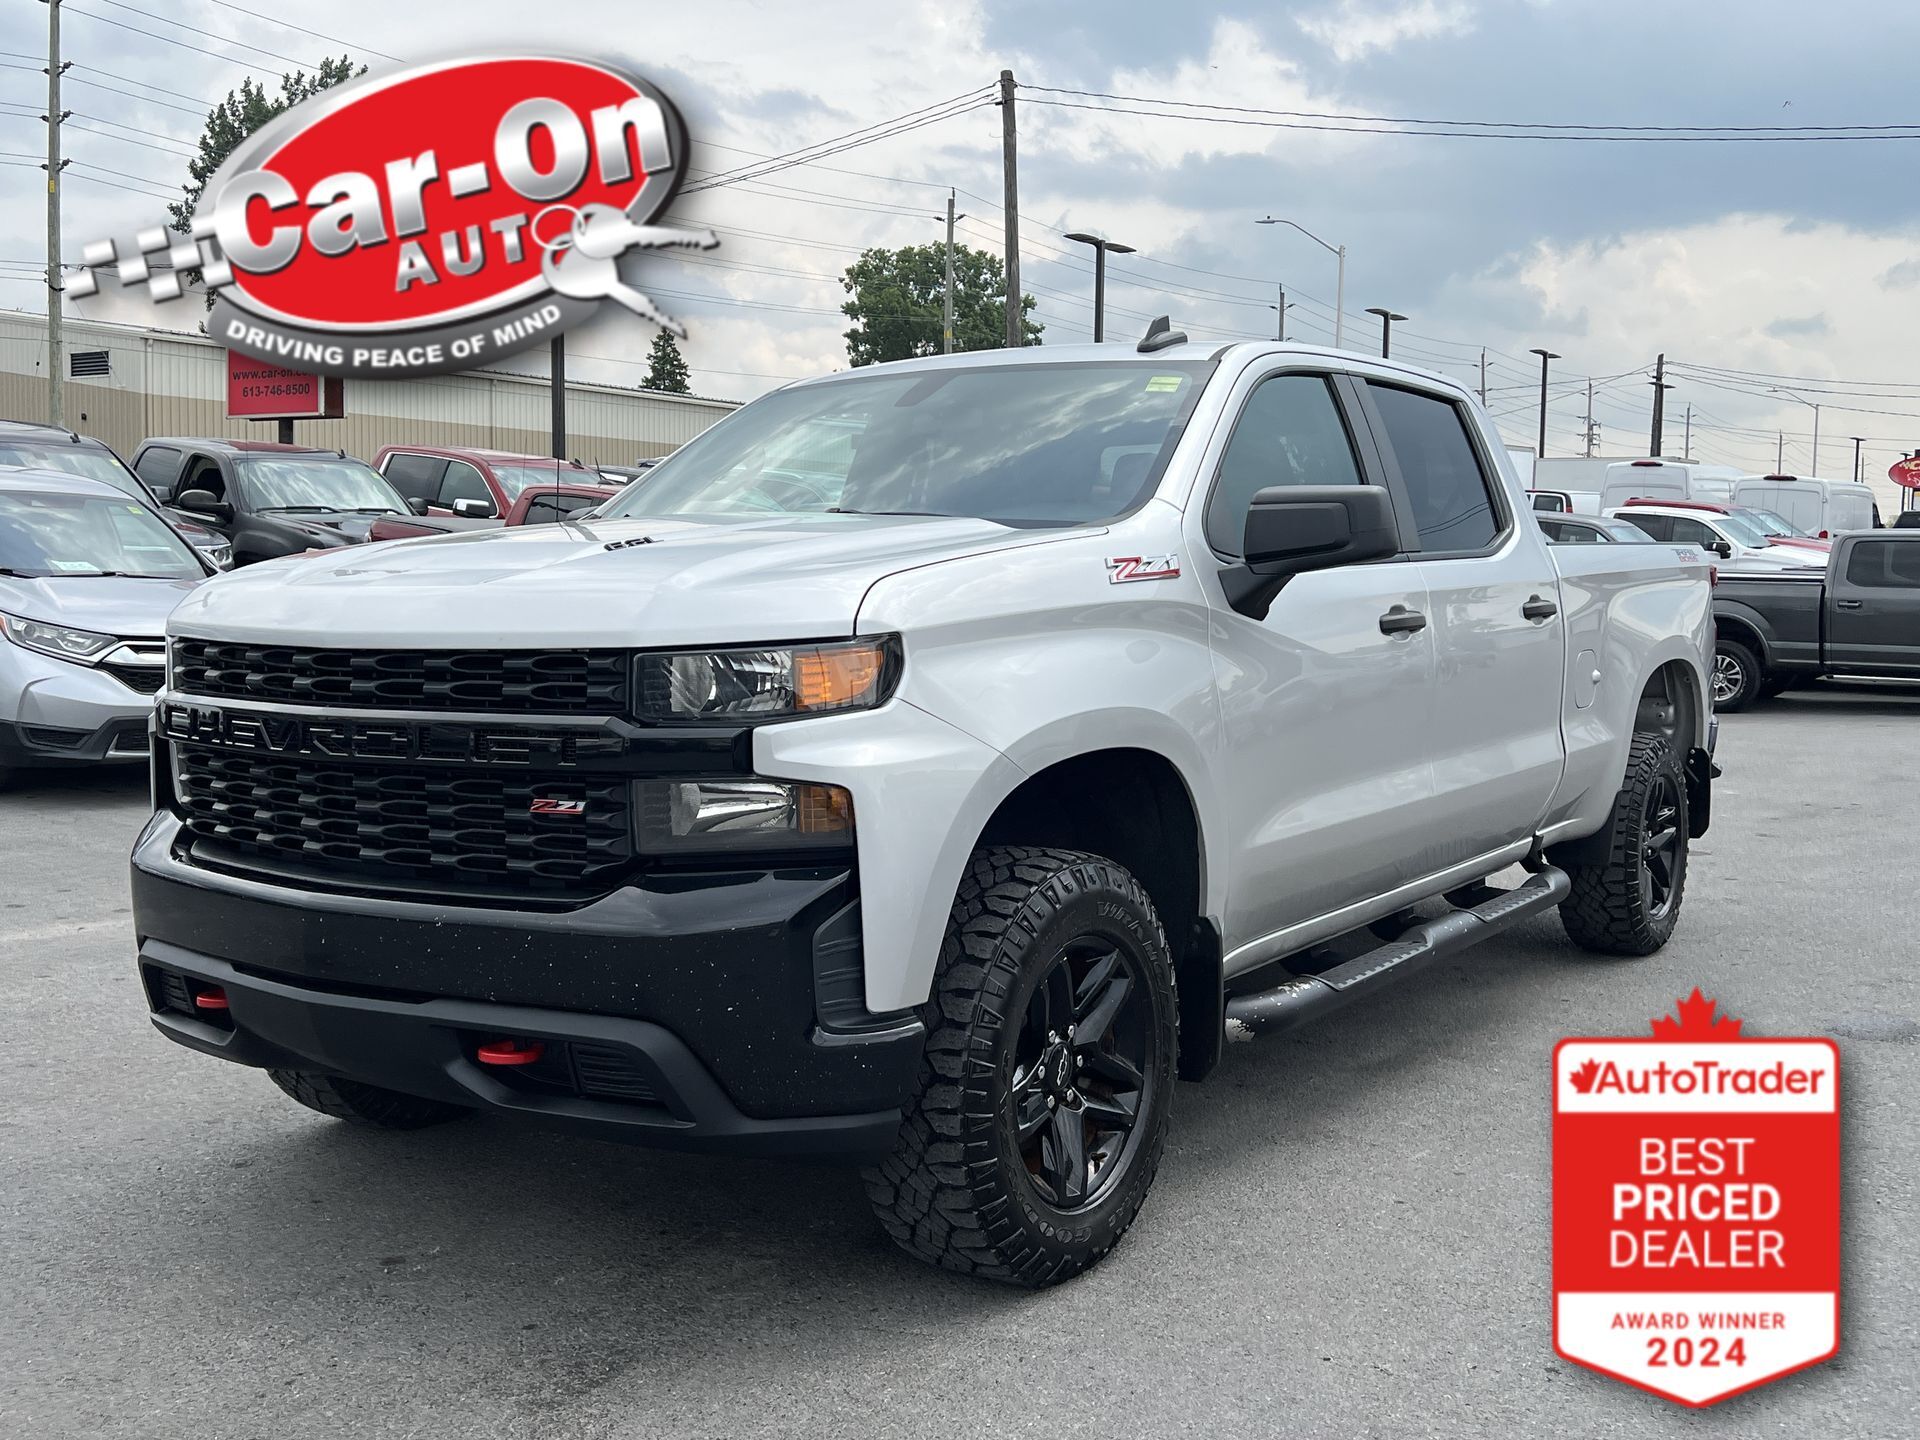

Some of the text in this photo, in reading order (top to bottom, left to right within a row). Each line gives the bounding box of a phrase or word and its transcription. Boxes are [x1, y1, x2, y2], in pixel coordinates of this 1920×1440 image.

[232, 368, 317, 380] www.car-on.co
[242, 383, 310, 397] 613-746-8500
[1104, 553, 1181, 584] Z71
[162, 705, 602, 766] CHEVROLET
[529, 798, 586, 815] Z71
